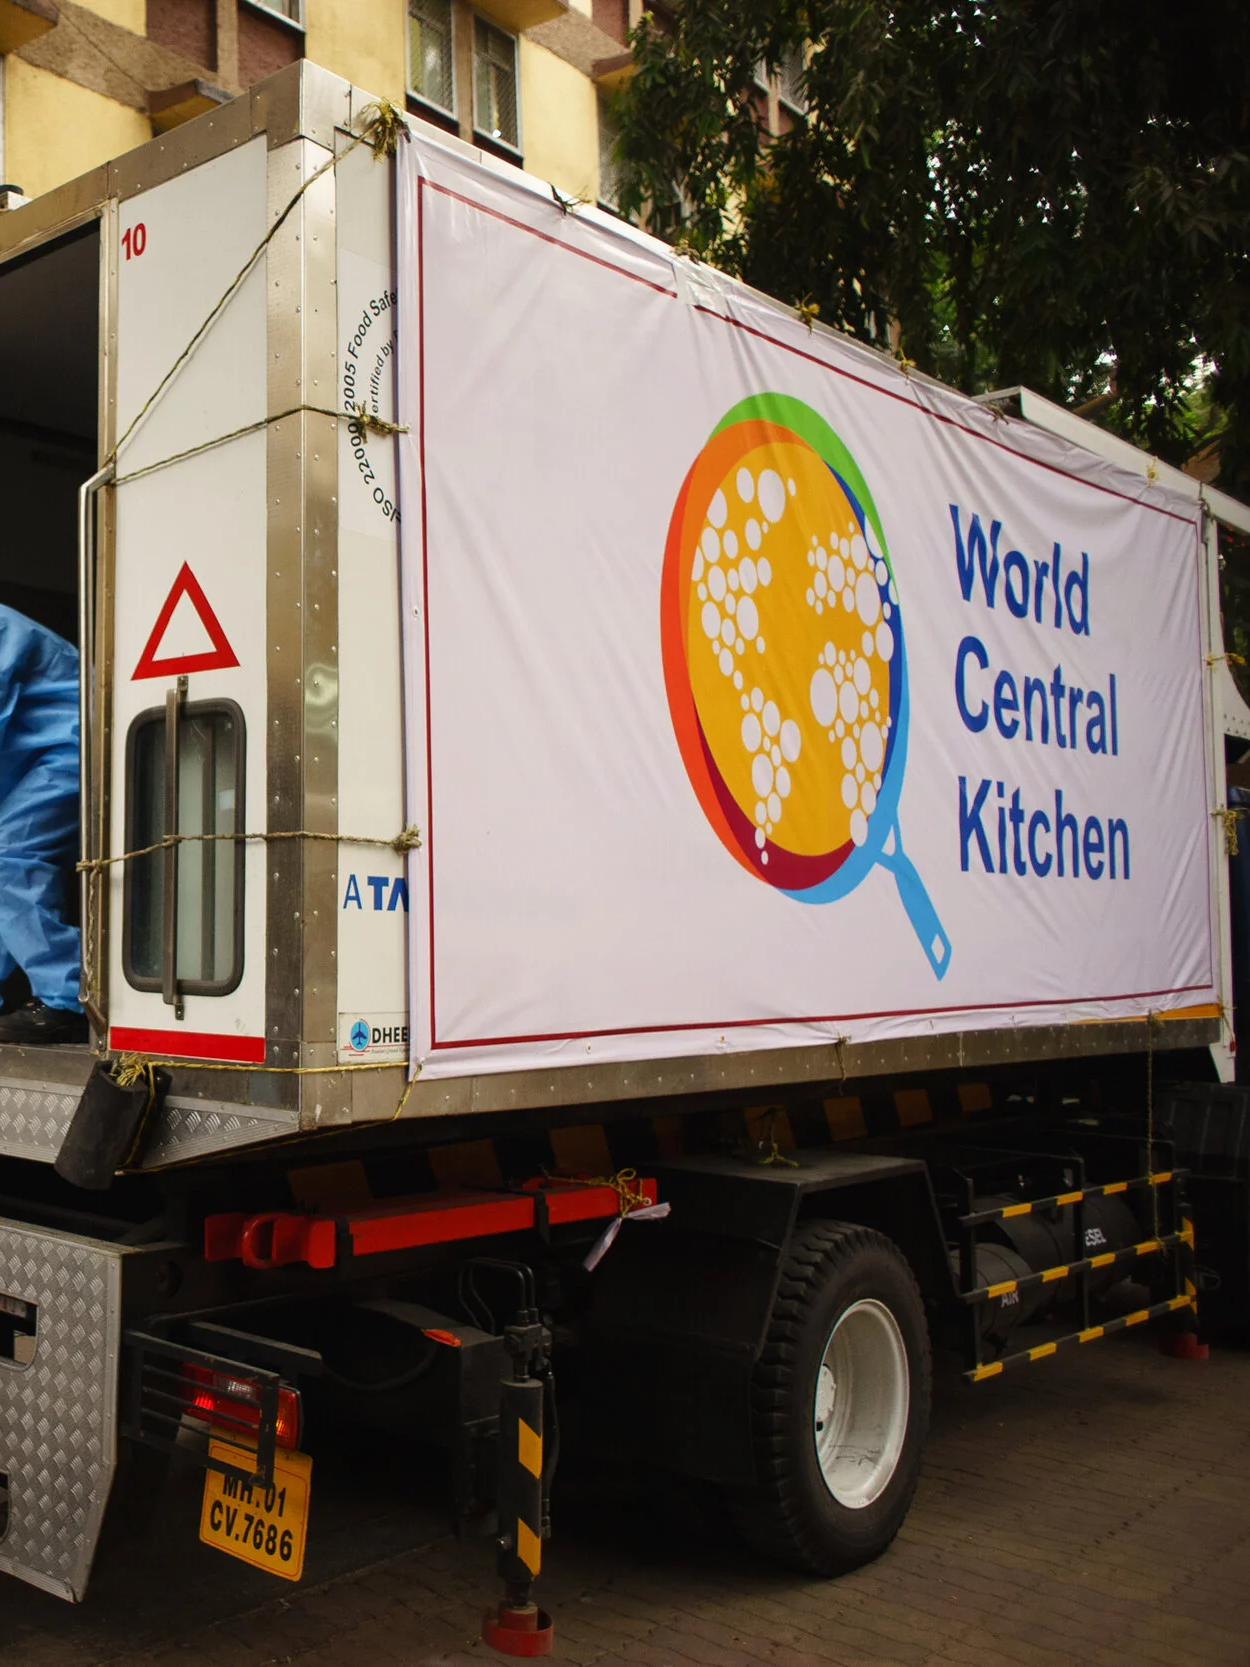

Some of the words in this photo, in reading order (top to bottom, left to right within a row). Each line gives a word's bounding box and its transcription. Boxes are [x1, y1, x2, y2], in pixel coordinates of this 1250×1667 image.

[121, 223, 146, 260] 10
[347, 310, 373, 360] Food
[370, 354, 385, 413] ertified
[380, 340, 394, 356] by
[949, 504, 1090, 636] World
[955, 636, 1118, 756] Central
[958, 775, 1130, 880] Kitchen
[343, 874, 362, 909] A
[372, 1026, 408, 1043] DHEE
[1085, 1228, 1107, 1246] ESEL
[210, 1500, 293, 1561] CV.7686
